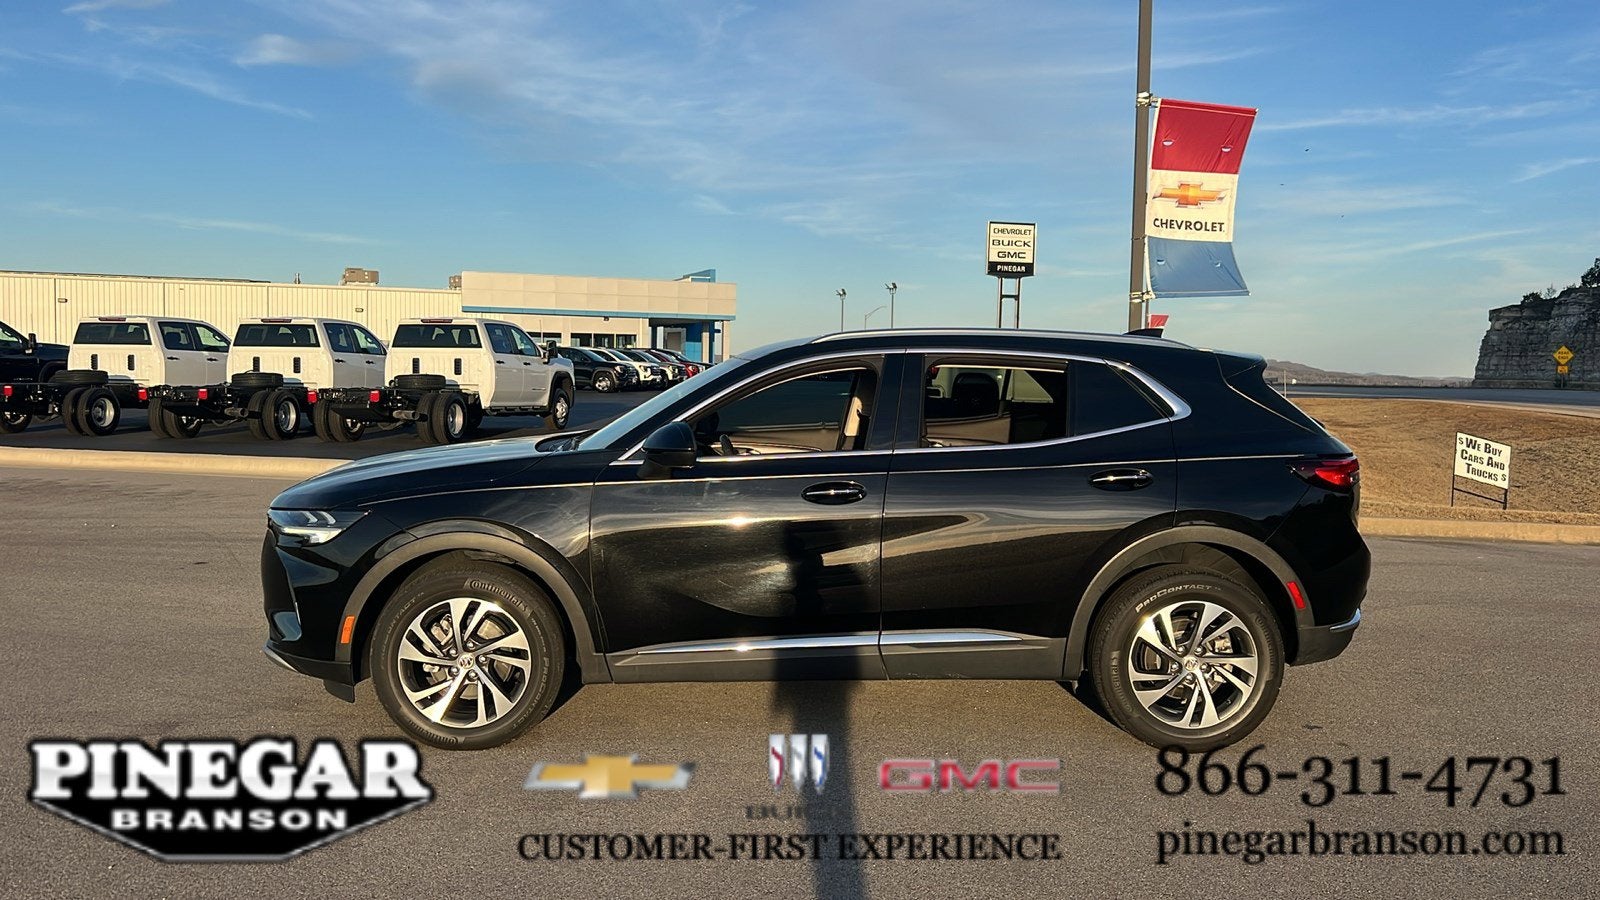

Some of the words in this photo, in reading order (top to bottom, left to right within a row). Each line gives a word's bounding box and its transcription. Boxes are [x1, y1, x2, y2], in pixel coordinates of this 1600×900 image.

[993, 227, 1032, 236] CHEVROLET
[1153, 217, 1225, 232] CHEVROLET
[992, 239, 1032, 248] BUICK
[997, 251, 1026, 259] GMC
[1465, 437, 1481, 452] WE
[1484, 443, 1502, 457] BUY
[1460, 449, 1484, 465] CARS
[1486, 457, 1505, 471] AND
[1465, 463, 1498, 481] TRUCKS
